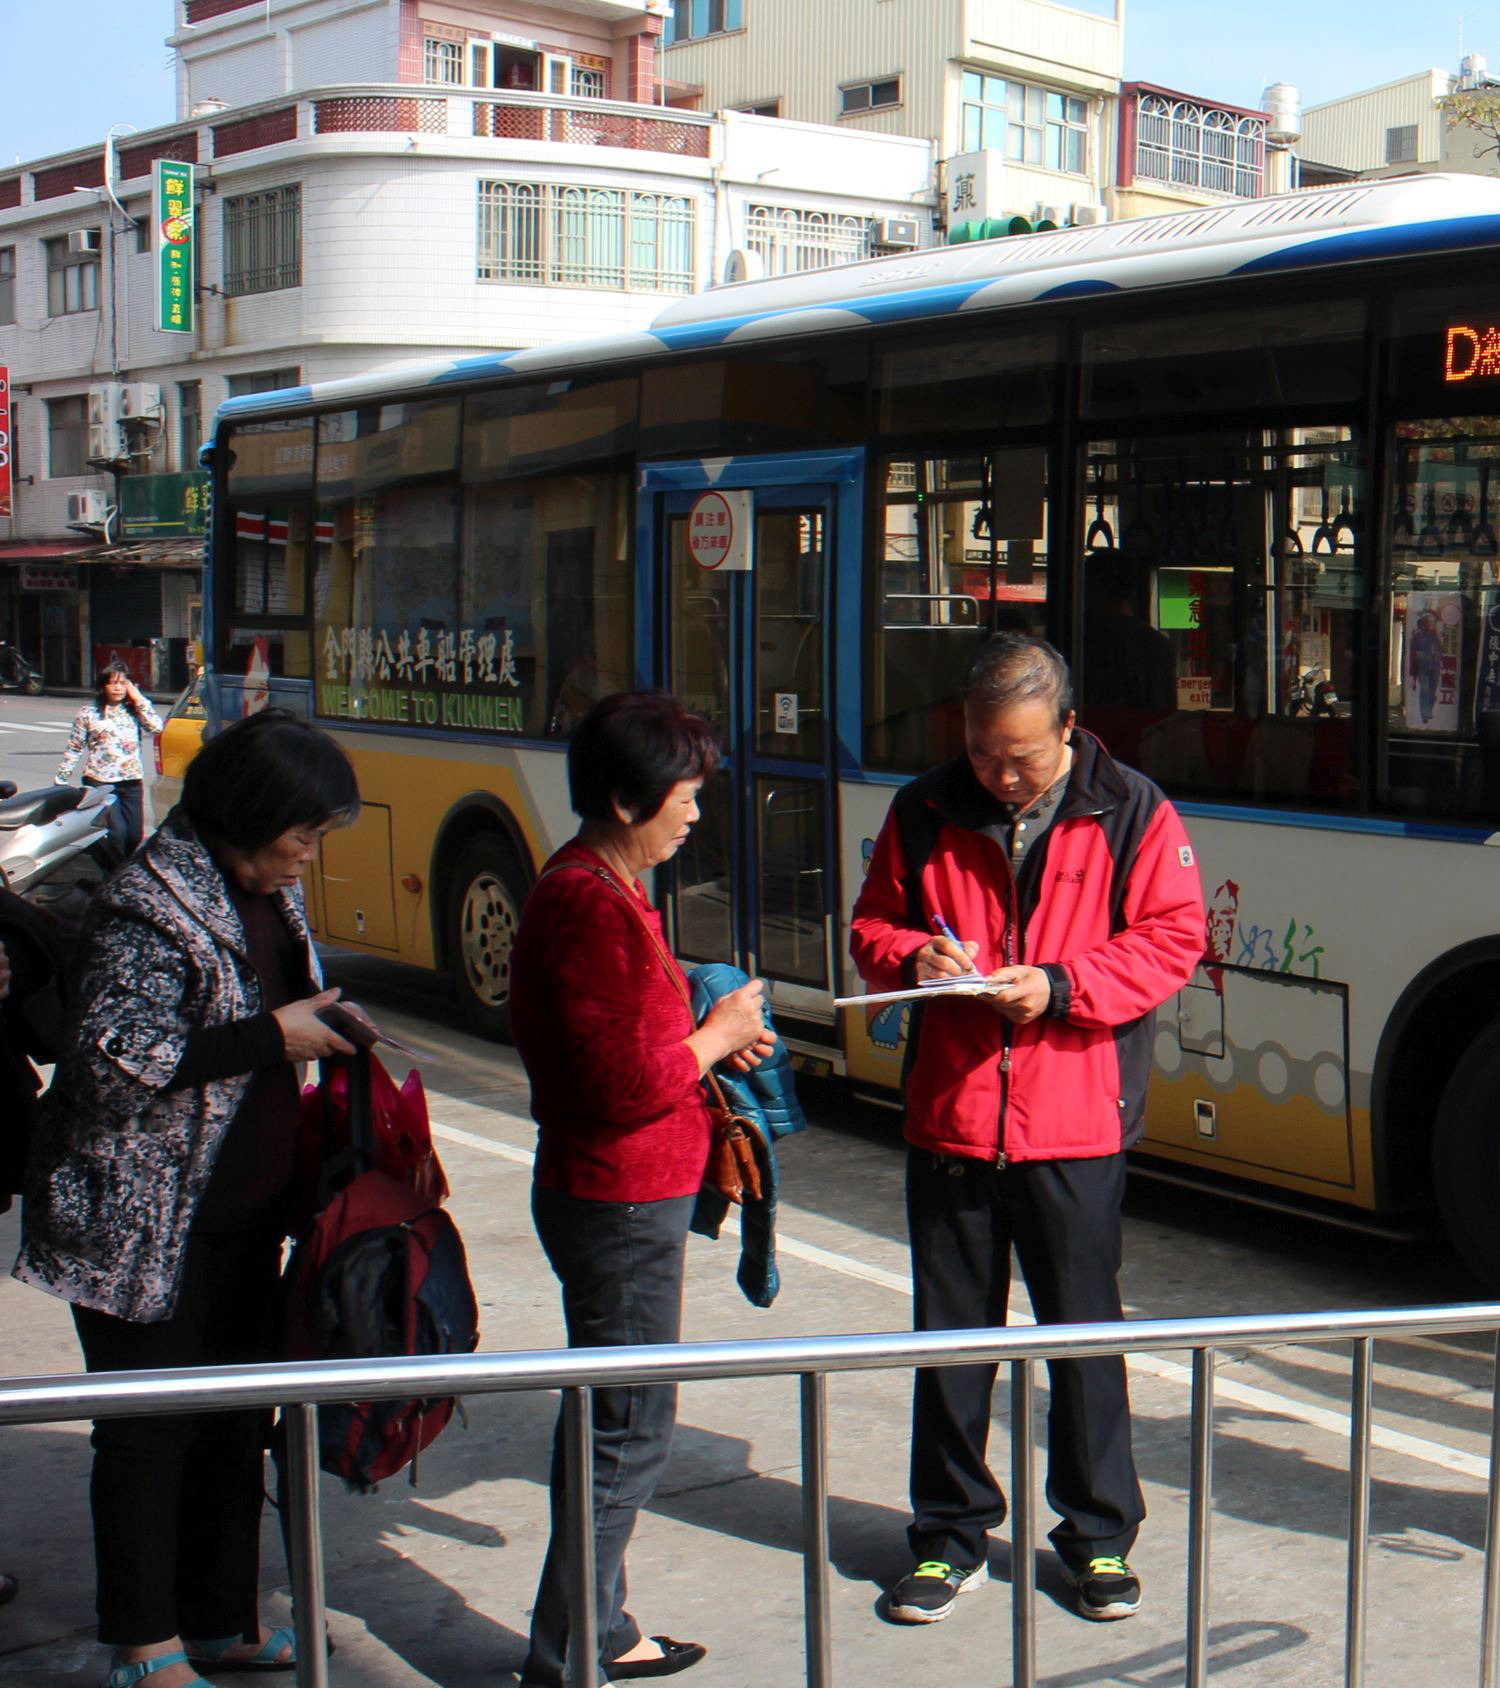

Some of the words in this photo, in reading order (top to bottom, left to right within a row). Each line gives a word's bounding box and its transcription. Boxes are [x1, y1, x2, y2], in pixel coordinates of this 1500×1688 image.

[695, 512, 726, 528] 請注意
[691, 535, 728, 551] 後方來車
[321, 684, 409, 722] WELCOME
[411, 690, 439, 725] TO
[442, 692, 524, 732] KINMEN
